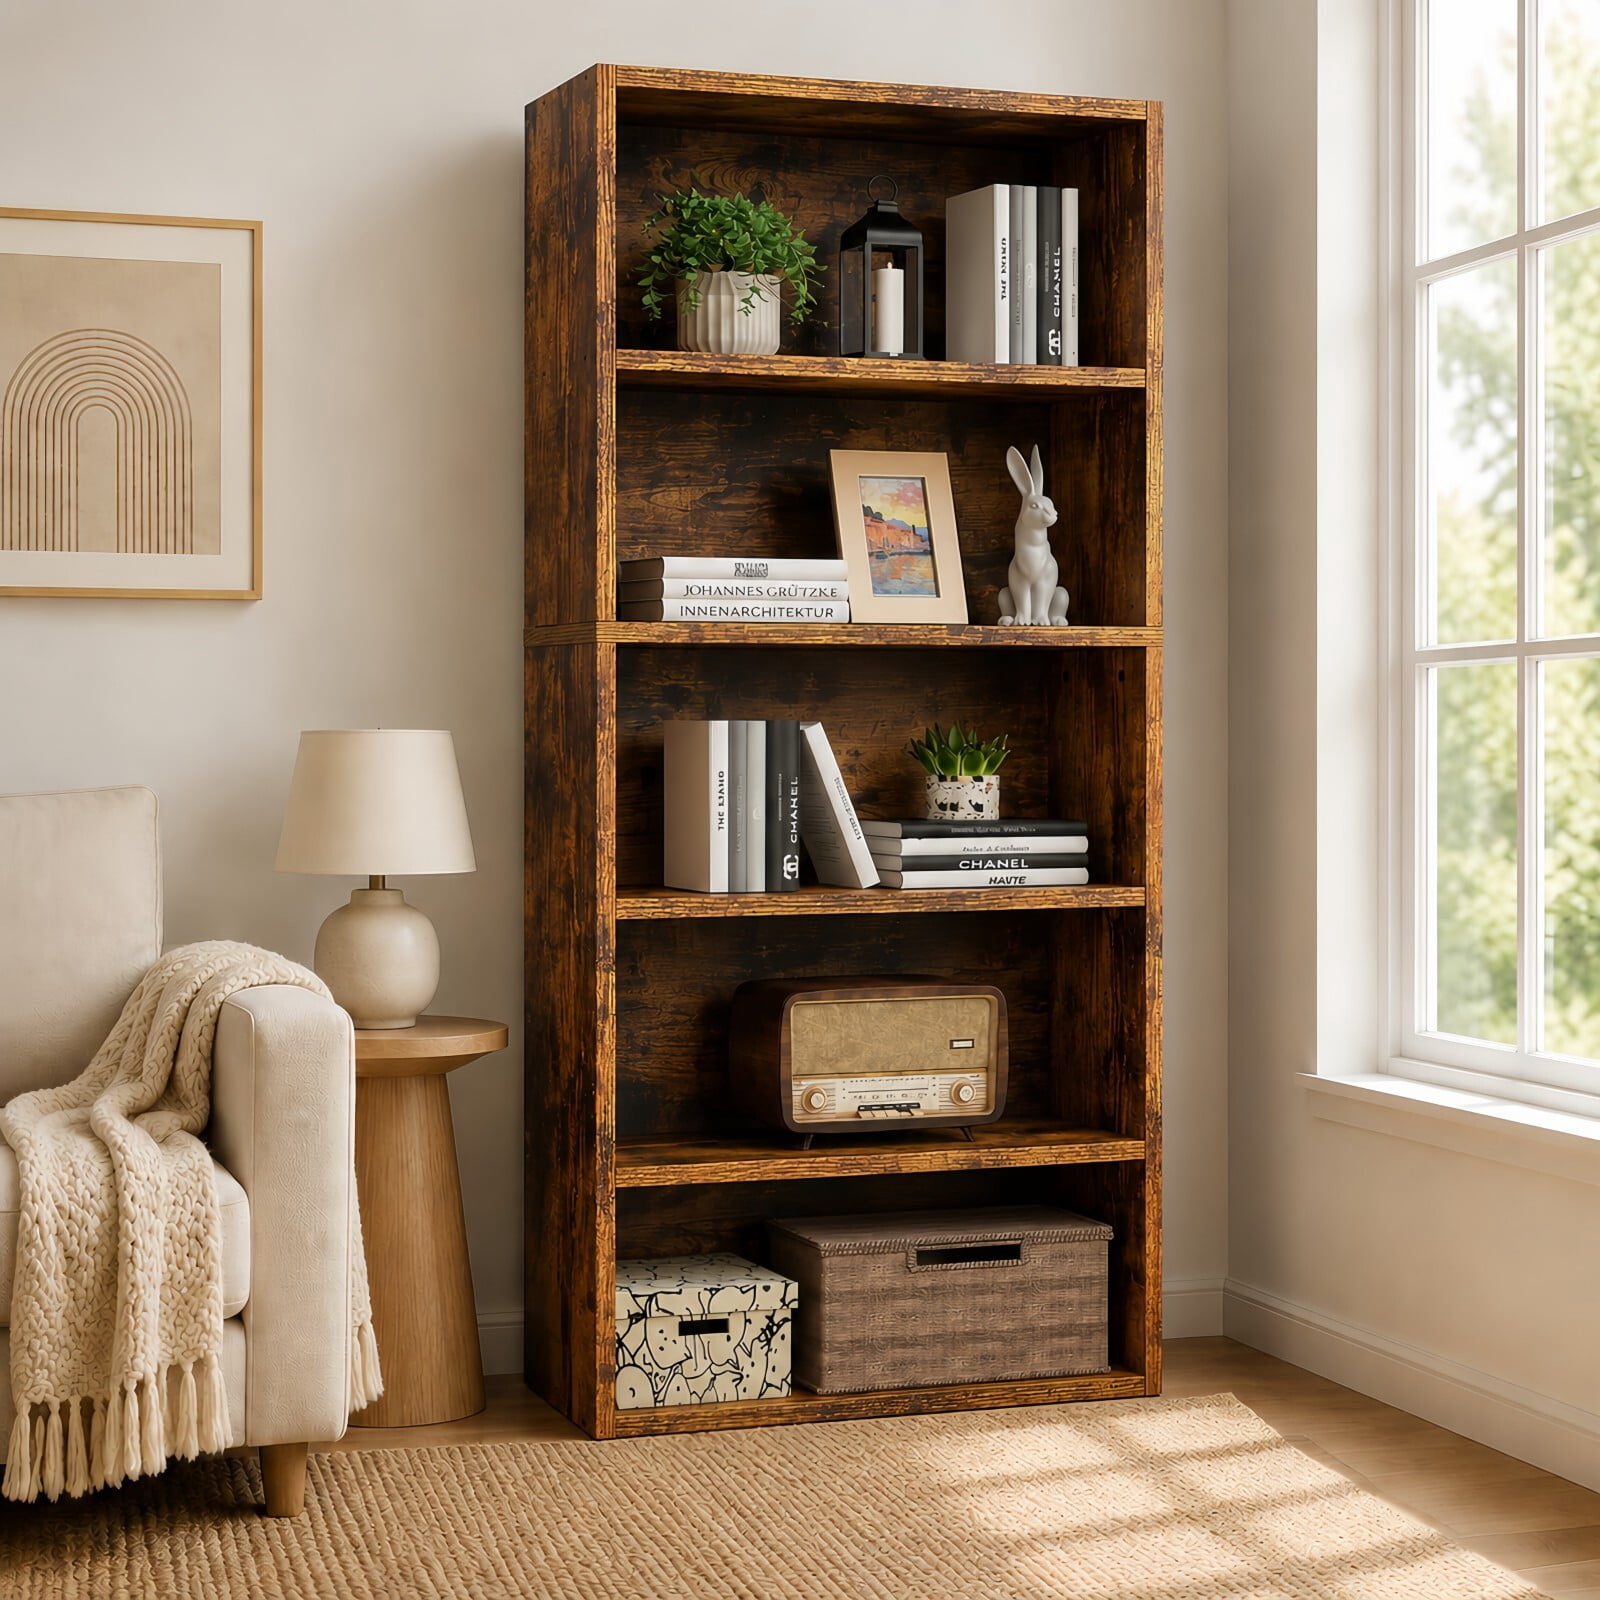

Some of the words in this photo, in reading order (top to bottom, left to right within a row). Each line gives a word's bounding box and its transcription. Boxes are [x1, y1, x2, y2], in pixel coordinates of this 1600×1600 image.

[683, 584, 763, 597] JOHANNES
[767, 584, 838, 598] GRÜTZKE
[680, 605, 834, 618] INNENARCHITEKTUR
[958, 858, 1029, 870] CHANEL
